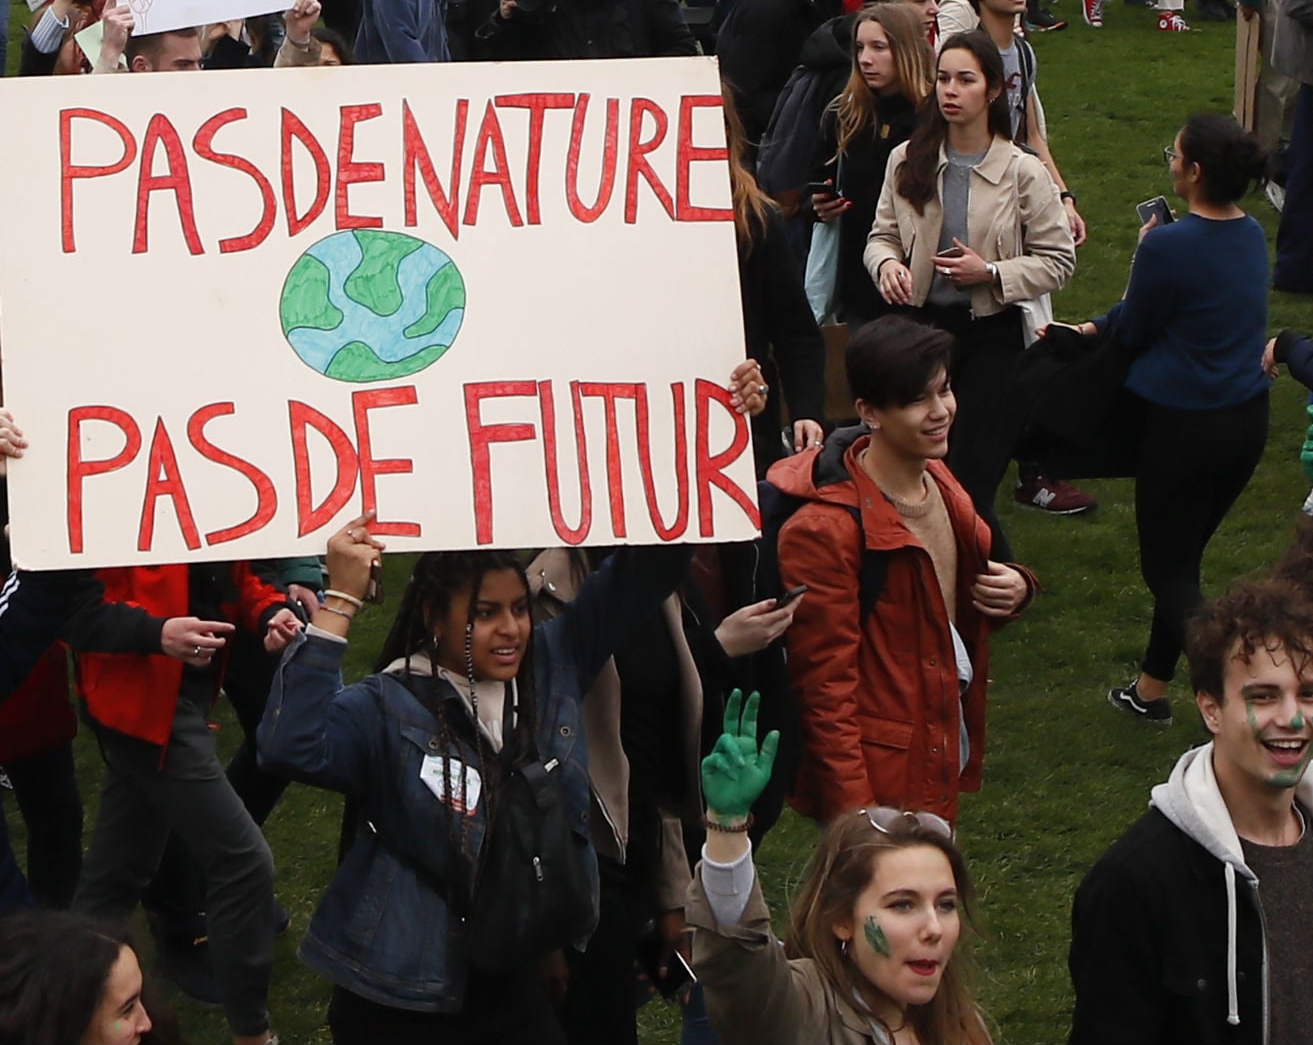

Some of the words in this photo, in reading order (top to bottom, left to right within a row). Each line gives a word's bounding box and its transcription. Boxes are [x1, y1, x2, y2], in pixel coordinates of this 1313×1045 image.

[59, 106, 278, 255] PAS
[281, 102, 386, 238] DE
[403, 92, 735, 240] NATURE
[67, 400, 278, 553] PAS
[288, 385, 422, 537] DE
[463, 379, 762, 547] FUTUR
